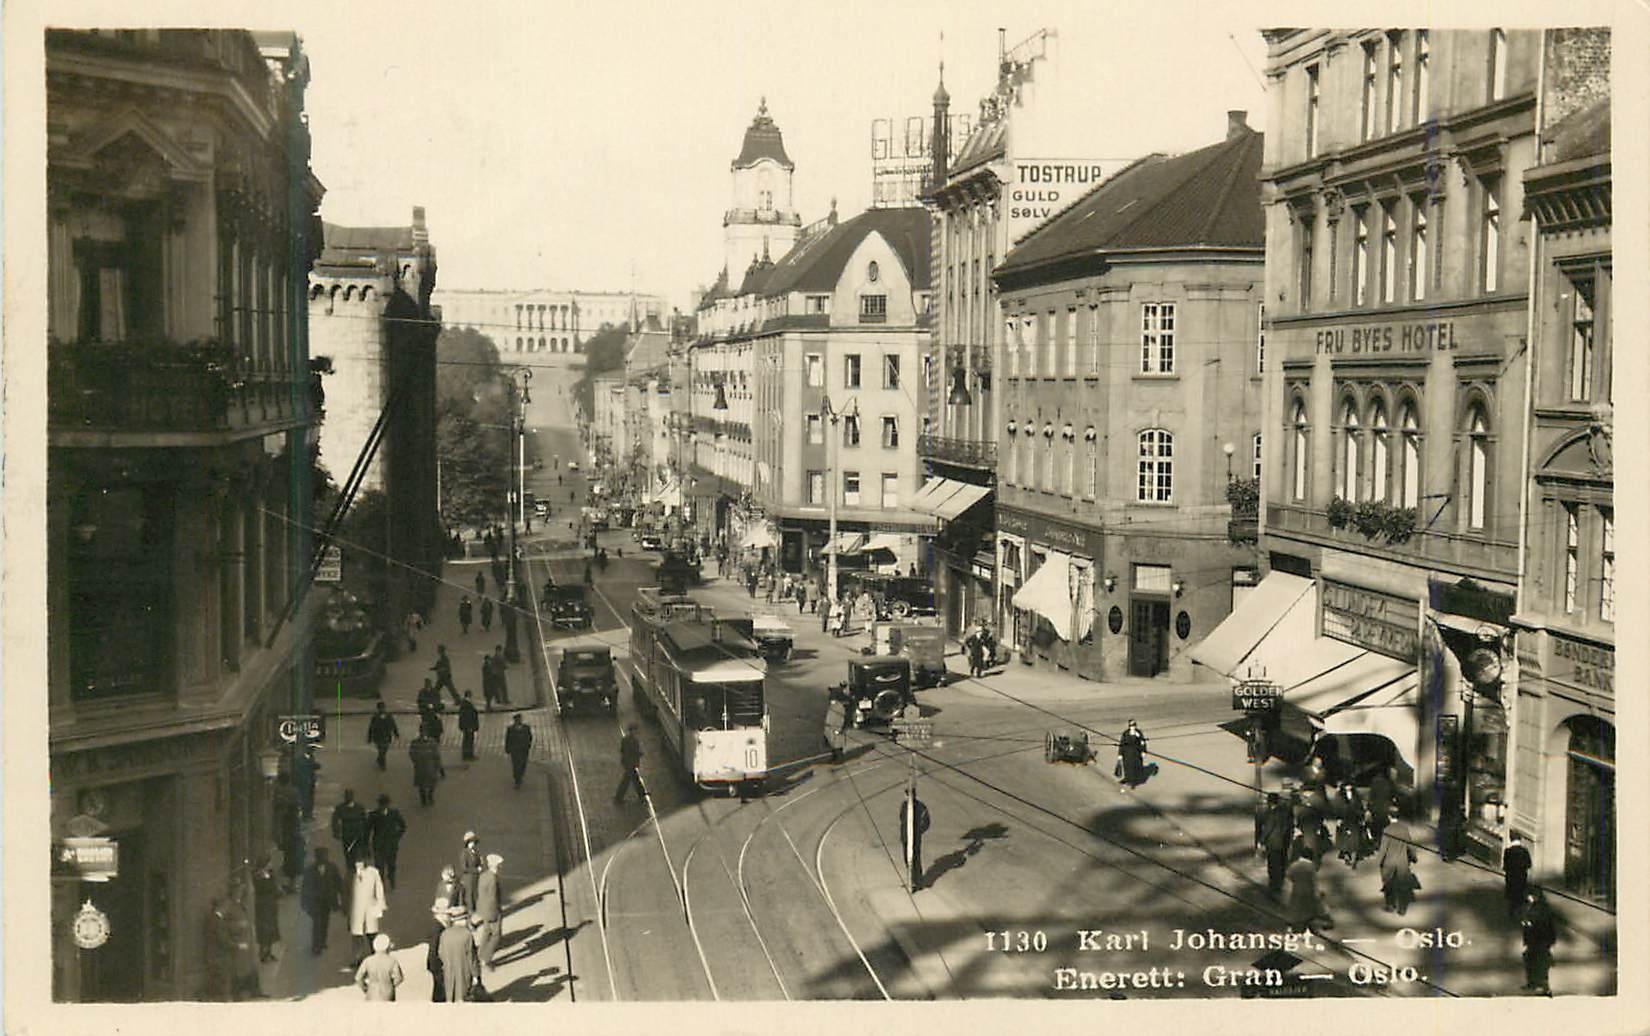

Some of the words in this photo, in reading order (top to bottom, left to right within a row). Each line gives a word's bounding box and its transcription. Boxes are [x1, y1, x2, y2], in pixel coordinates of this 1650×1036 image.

[1017, 164, 1102, 184] TOSTRUP
[1012, 190, 1060, 202] GULD
[1010, 207, 1051, 219] SØLV
[1316, 330, 1344, 355] FRU
[1352, 326, 1393, 353] BYES
[1402, 322, 1458, 351] HOTEL
[1574, 665, 1615, 692] BANK
[1234, 686, 1283, 697] GOLDEN
[1241, 698, 1275, 709] WEST
[744, 748, 758, 769] 10
